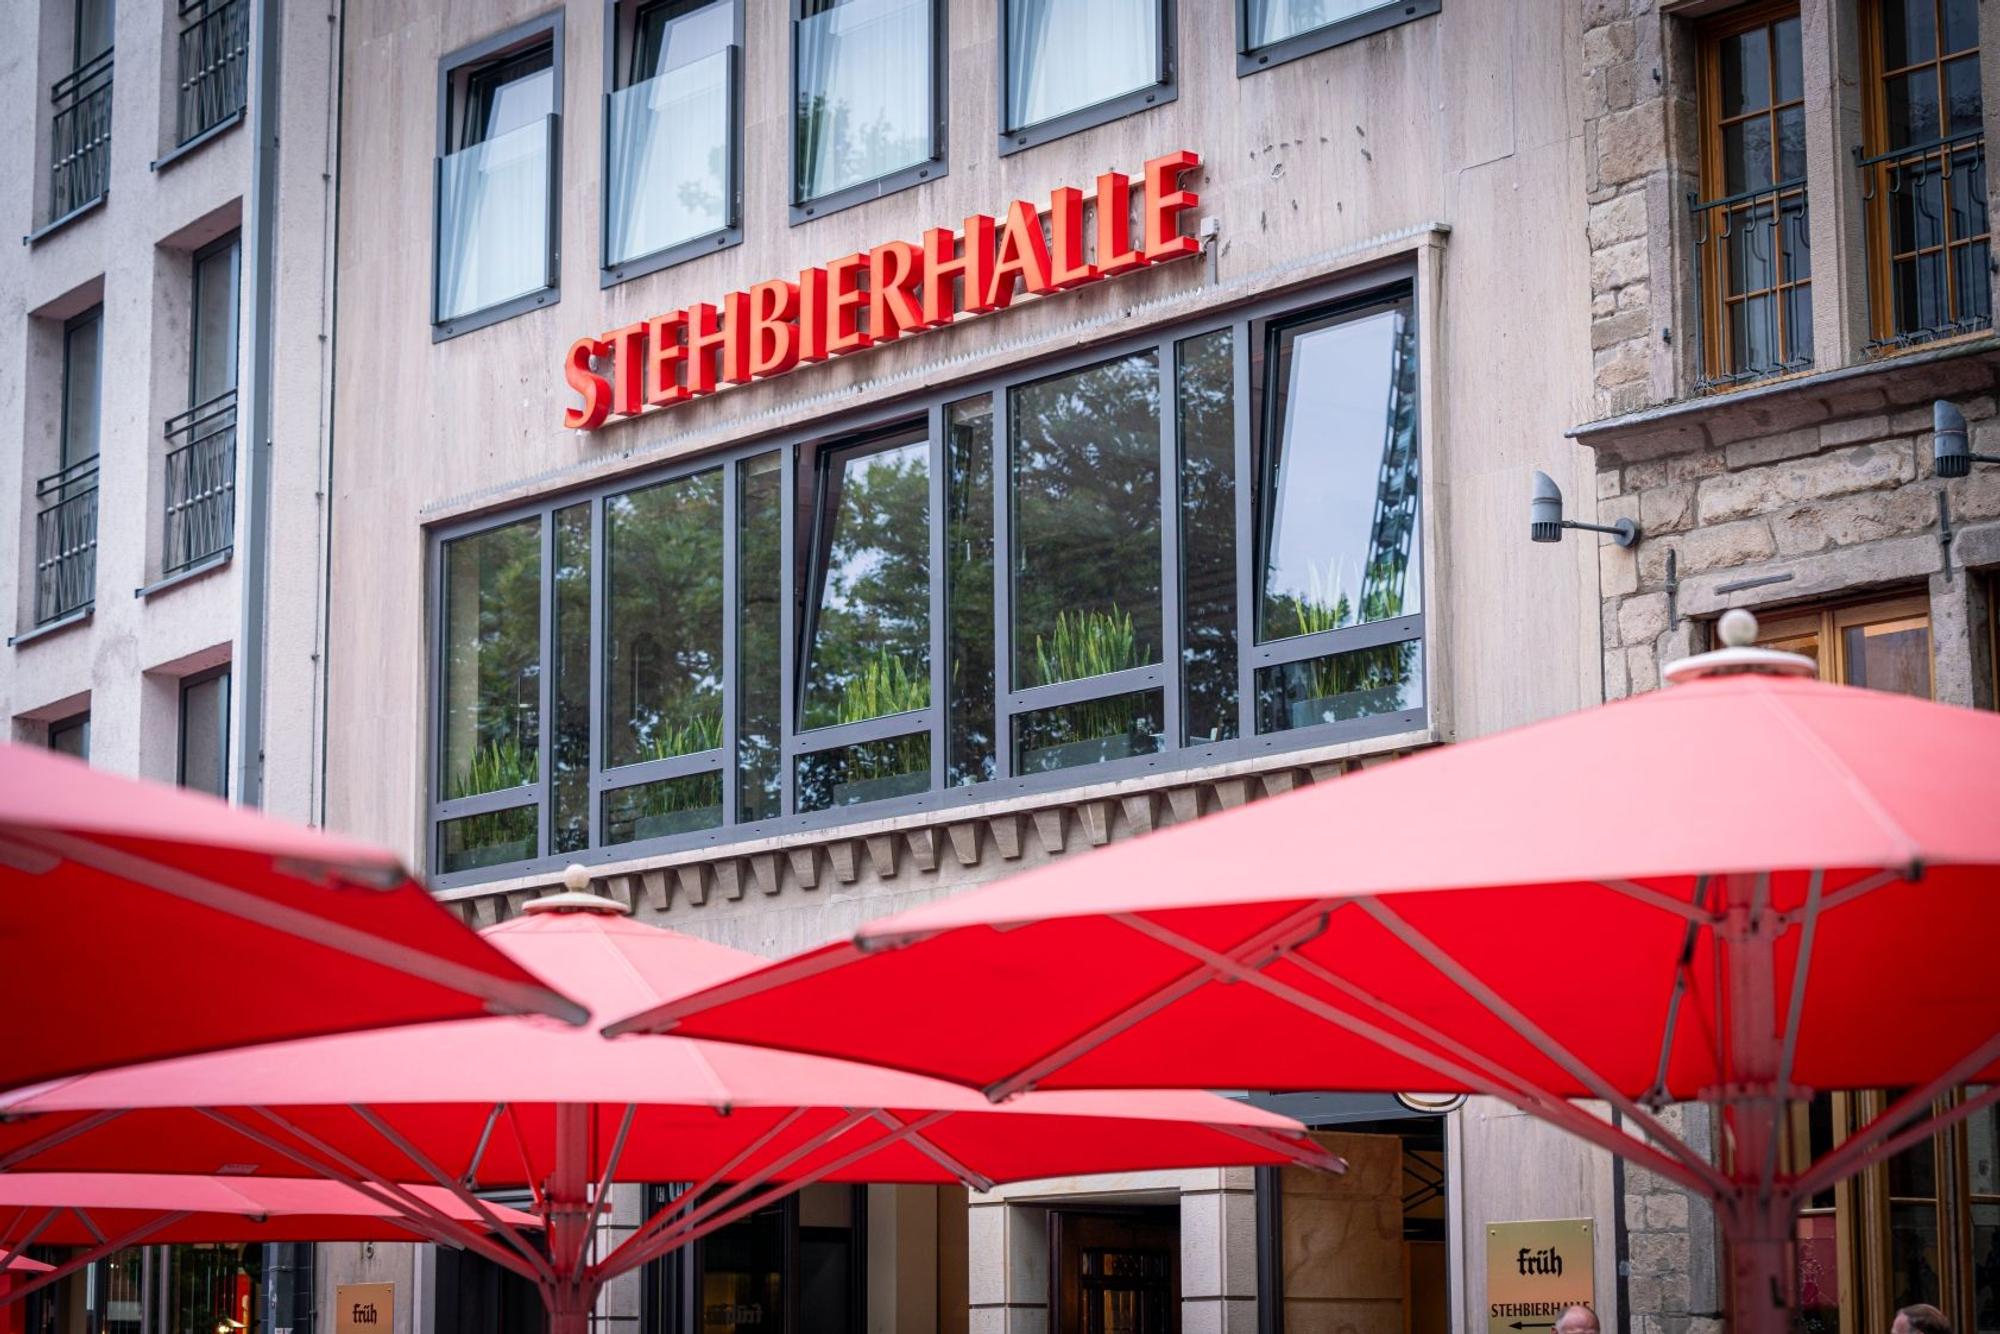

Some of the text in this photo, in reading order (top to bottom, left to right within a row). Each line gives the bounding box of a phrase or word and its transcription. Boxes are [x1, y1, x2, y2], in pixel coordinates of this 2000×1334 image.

[564, 150, 1200, 431] STEHBIERHALLE
[1517, 1246, 1562, 1277] früh
[352, 1303, 377, 1325] früh
